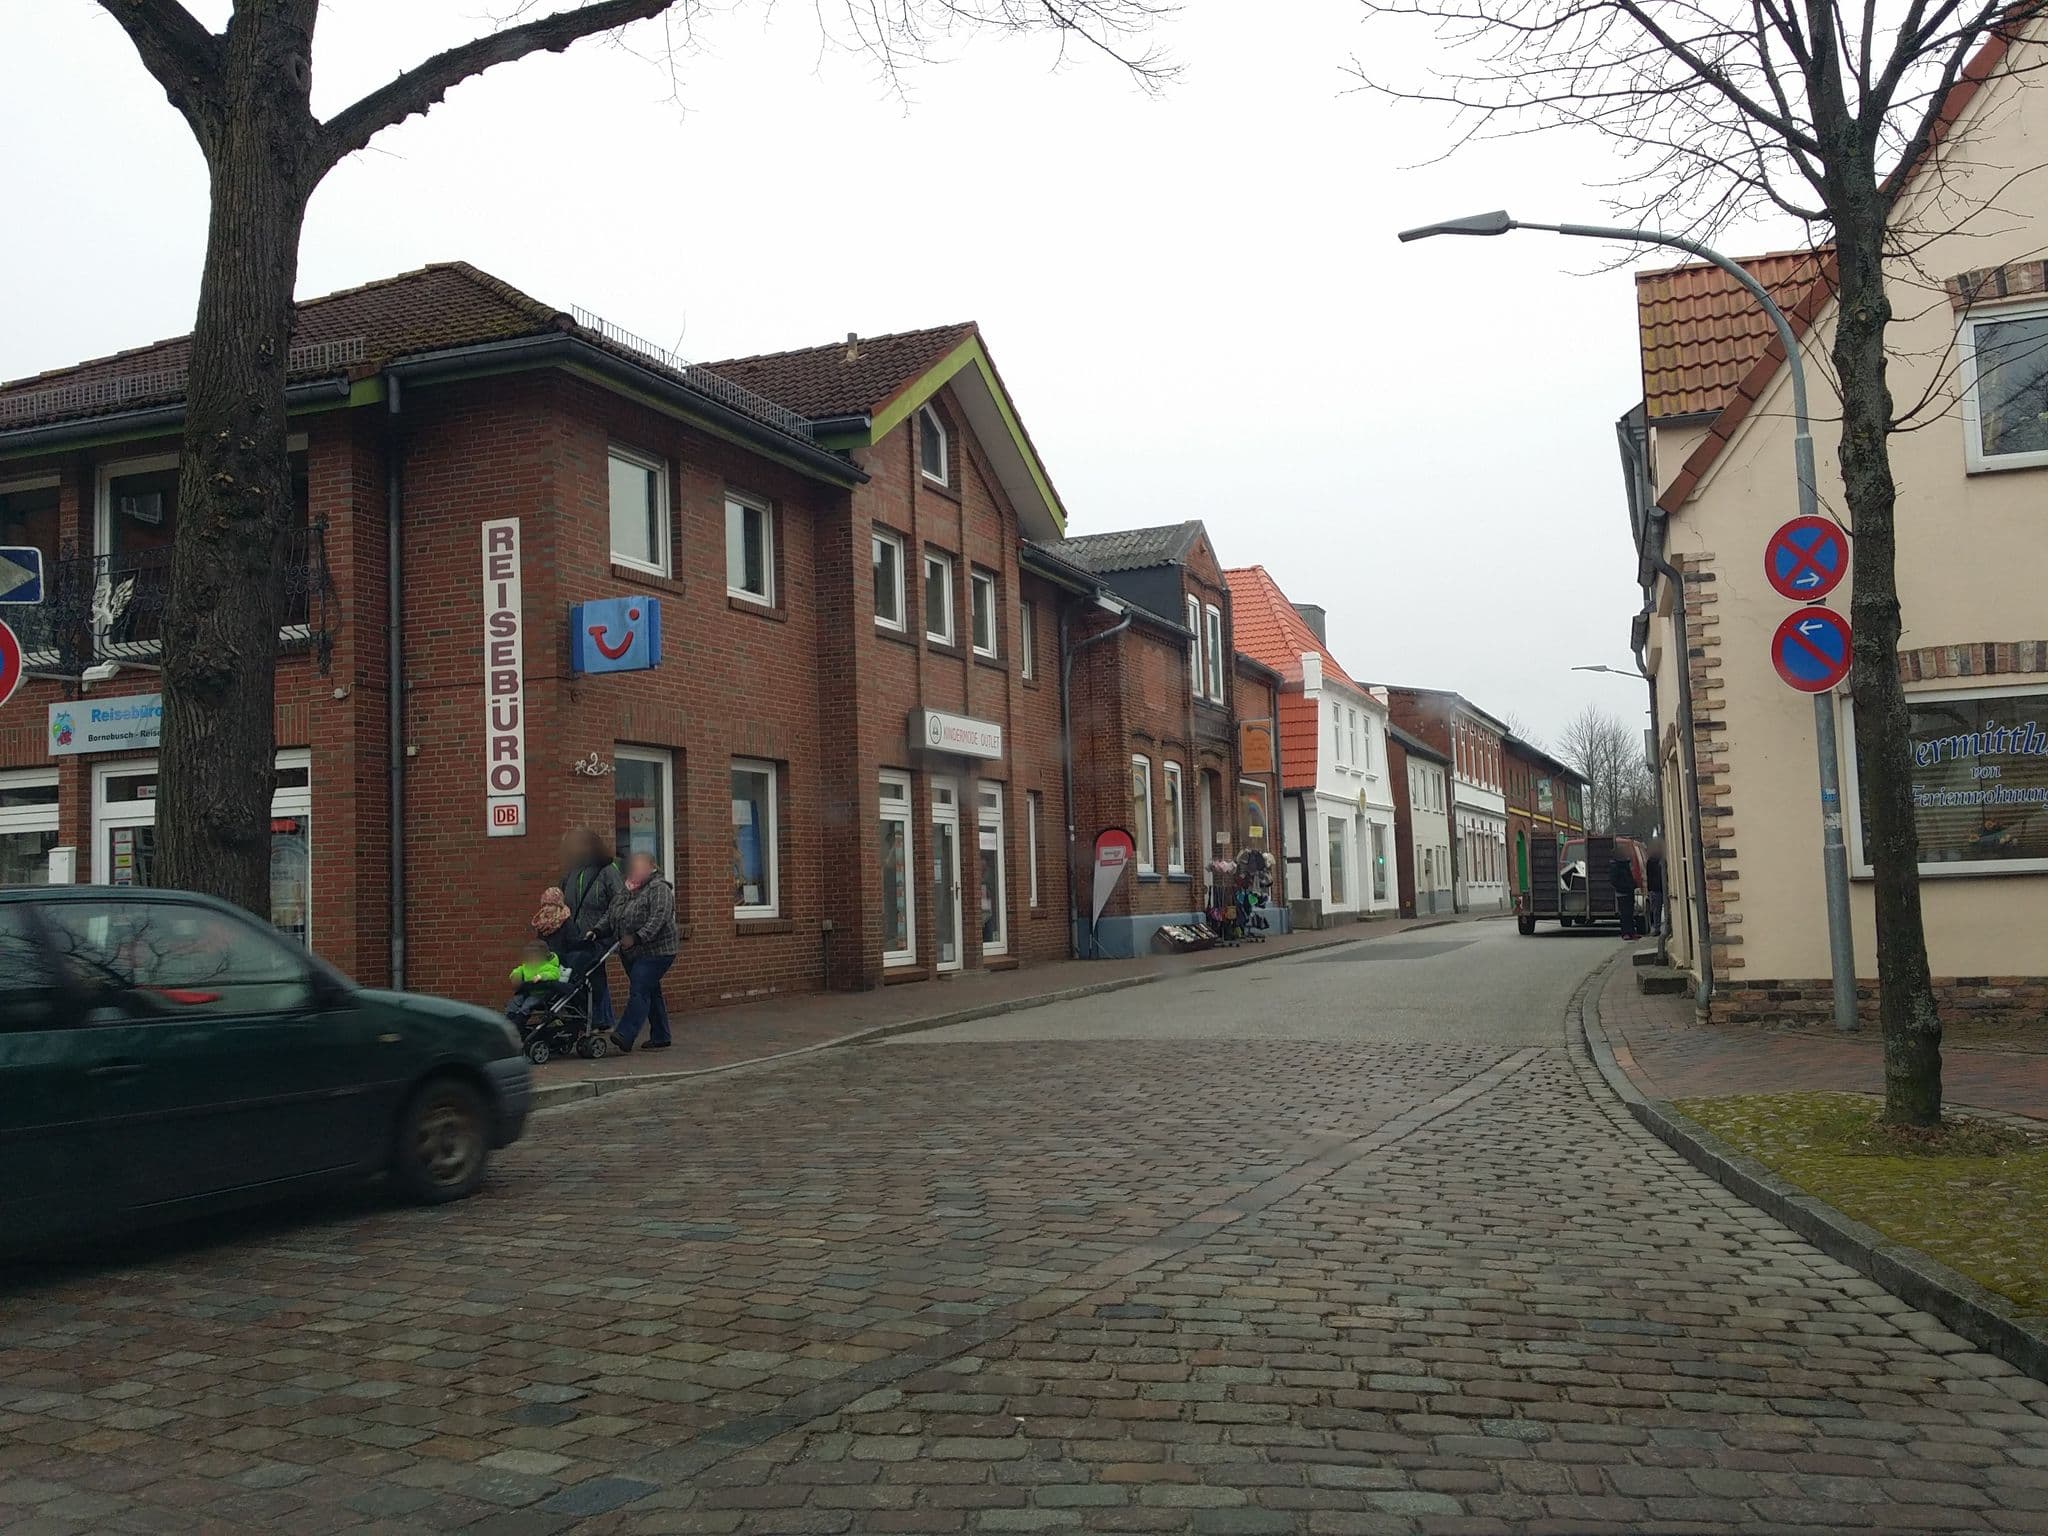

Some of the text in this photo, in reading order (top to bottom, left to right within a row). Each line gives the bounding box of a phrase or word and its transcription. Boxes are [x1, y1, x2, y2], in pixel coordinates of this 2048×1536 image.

[488, 526, 521, 791] REISEBÜRO
[91, 704, 162, 722] Reisebüro
[88, 731, 134, 742] Bornebusch
[1909, 720, 2048, 767] ermittlu
[1970, 765, 2001, 779] von
[495, 807, 517, 824] DB
